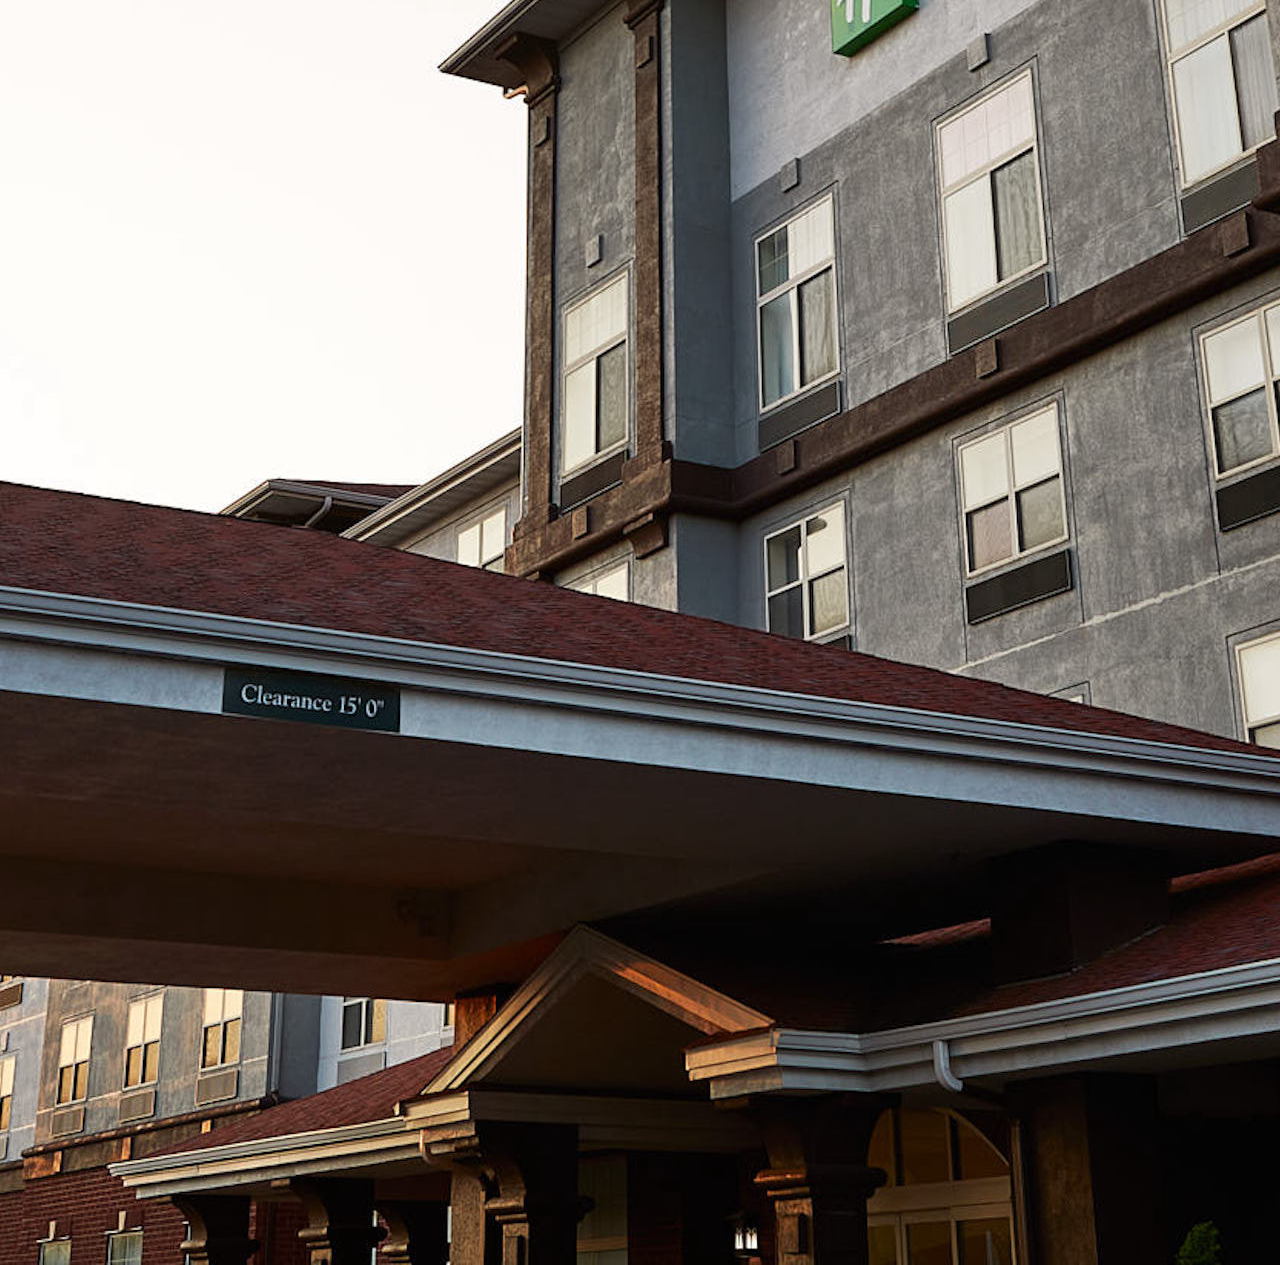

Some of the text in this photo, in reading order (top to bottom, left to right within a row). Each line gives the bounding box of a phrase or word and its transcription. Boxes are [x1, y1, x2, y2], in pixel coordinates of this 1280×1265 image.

[240, 683, 385, 718] Clearance 15' 0"
